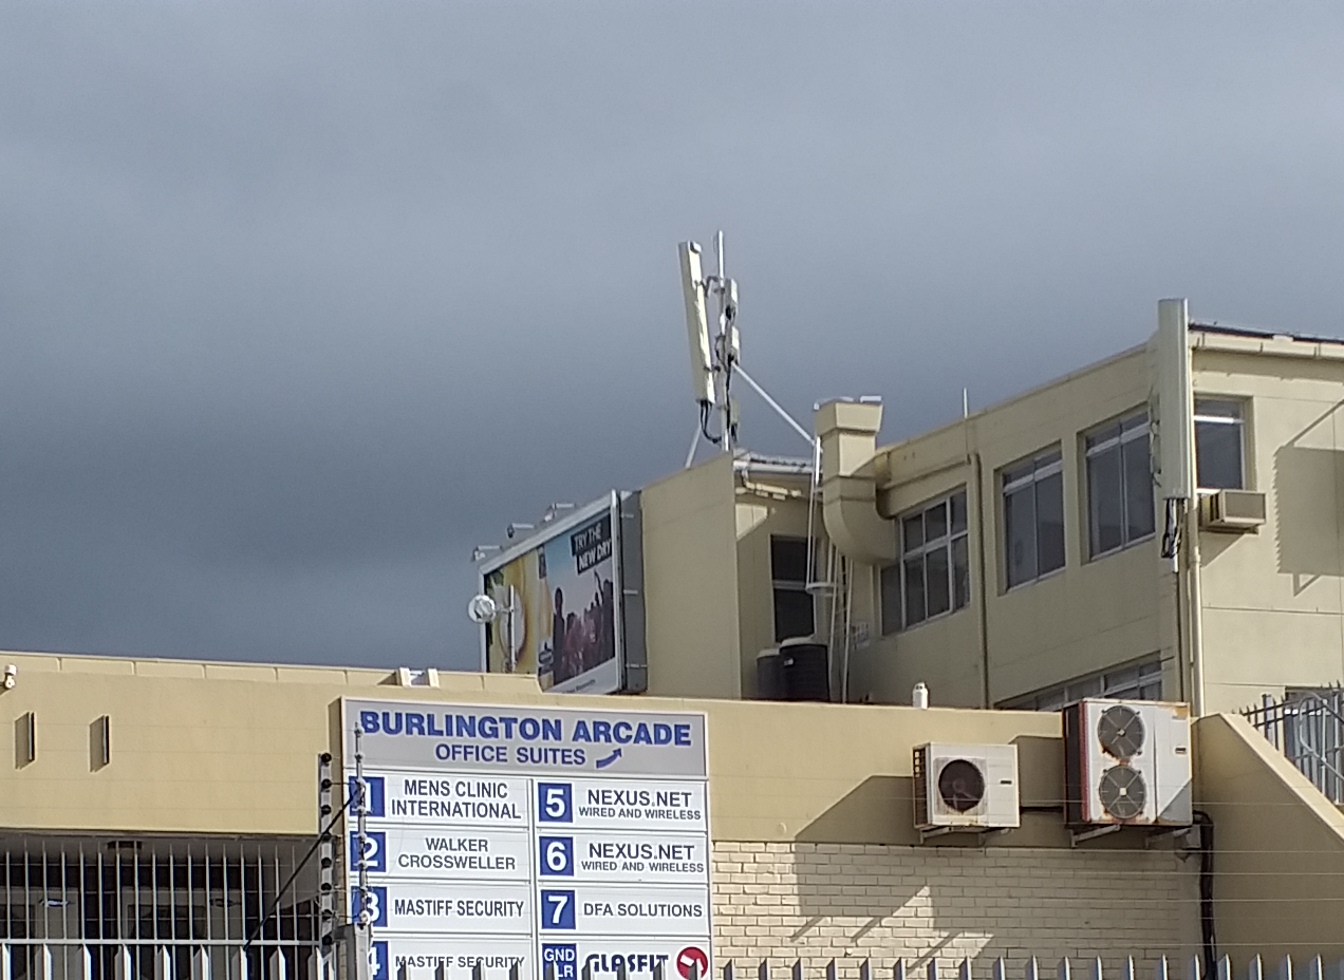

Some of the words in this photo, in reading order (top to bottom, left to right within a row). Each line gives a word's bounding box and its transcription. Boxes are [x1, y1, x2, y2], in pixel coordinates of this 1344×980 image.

[360, 711, 562, 741] BURLINGTON
[572, 720, 692, 746] ARCADE
[435, 743, 508, 763] OFFICE
[516, 747, 586, 766] SUITES
[404, 779, 451, 797] MENS
[456, 781, 508, 799] CLINIC
[588, 789, 692, 808] NEXUS.NET
[391, 799, 522, 819] INTERNATIONAL
[545, 788, 566, 818] 5
[579, 806, 616, 818] WIRED
[618, 808, 642, 819] AND
[644, 809, 702, 821] WIRELESS
[358, 837, 378, 867] 2
[425, 837, 489, 853] WALKER
[589, 843, 695, 861] NEXUS.NET
[398, 854, 516, 870] CROSSWELLER
[546, 841, 567, 872] 6
[581, 860, 618, 871] WIRED
[622, 861, 645, 872] AND
[649, 862, 704, 873] WIRELESS
[362, 892, 380, 923] 3
[394, 899, 453, 917] MASTIFF
[457, 900, 524, 918] SECURITY
[548, 895, 568, 924] 7
[584, 903, 614, 917] DFA
[617, 903, 703, 918] SOLUTIONS
[395, 955, 454, 968] MASTIFF
[457, 955, 525, 968] SECURITY
[544, 948, 575, 962] GND
[549, 963, 574, 978] LR
